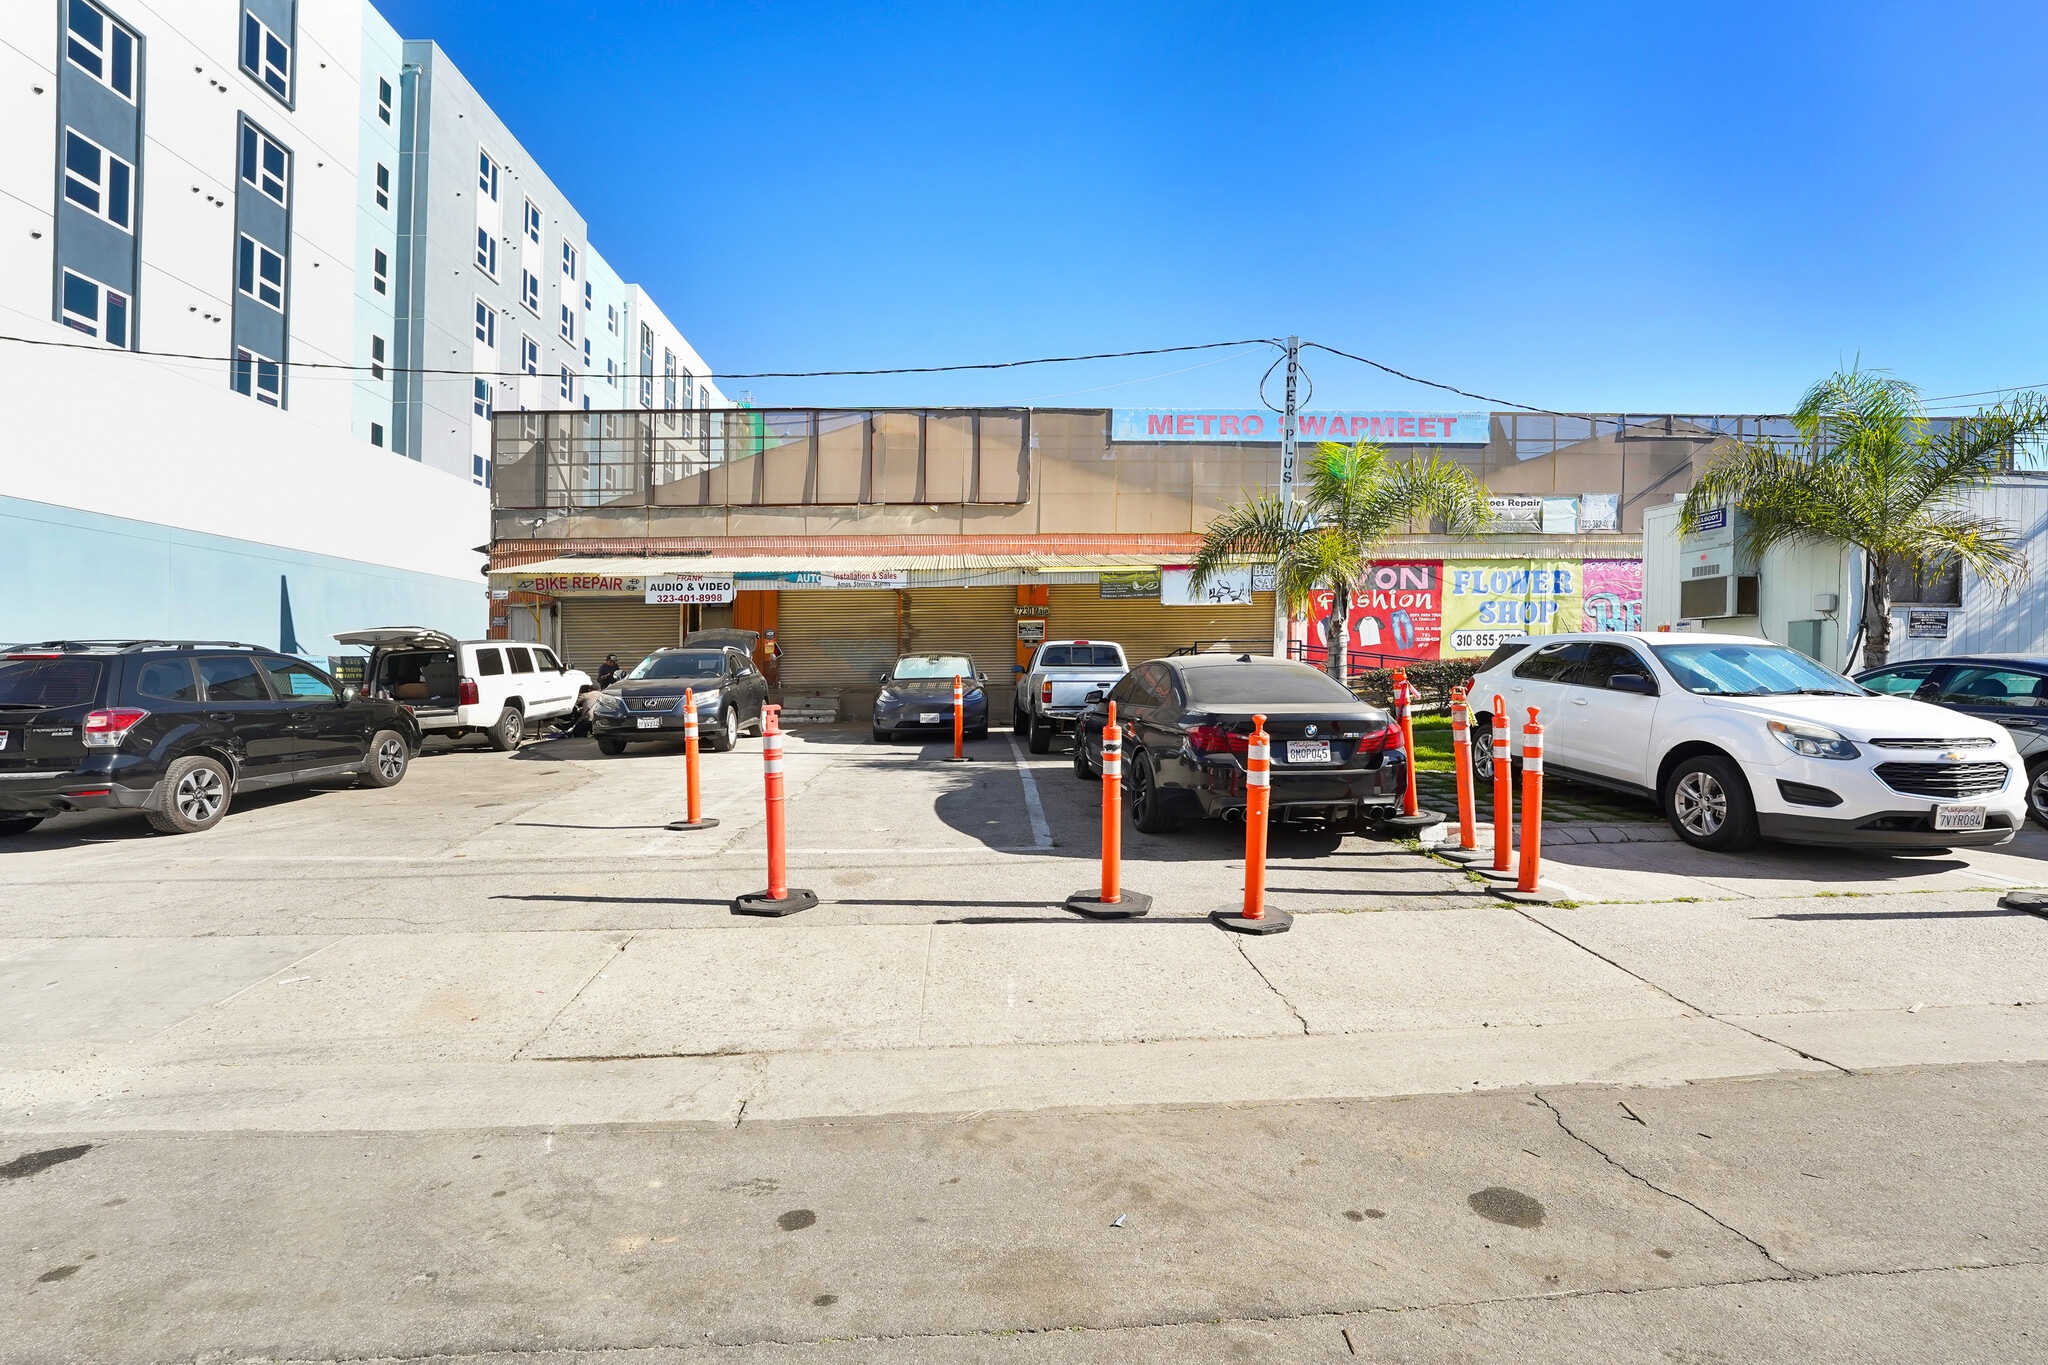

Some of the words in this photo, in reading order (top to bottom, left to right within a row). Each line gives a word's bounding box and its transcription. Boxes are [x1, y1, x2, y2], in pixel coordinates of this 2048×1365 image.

[1286, 347, 1298, 416] POWER
[1147, 414, 1264, 436] METRO
[1283, 428, 1295, 483] PLUS
[1508, 499, 1541, 509] Repair
[535, 576, 568, 591] BIKE
[572, 575, 623, 590] REPAIR
[833, 572, 867, 581] Installation
[871, 572, 878, 580] &
[878, 572, 898, 580] Sales
[1452, 569, 1574, 594] FLOWER
[649, 583, 684, 592] AUDIO
[686, 583, 695, 591] &
[697, 582, 731, 591] VIDEO
[656, 593, 723, 603] 323-401-8998
[1016, 606, 1033, 616] 7230
[1478, 600, 1558, 624] SHOP
[1940, 814, 1981, 826] 7VYR084
